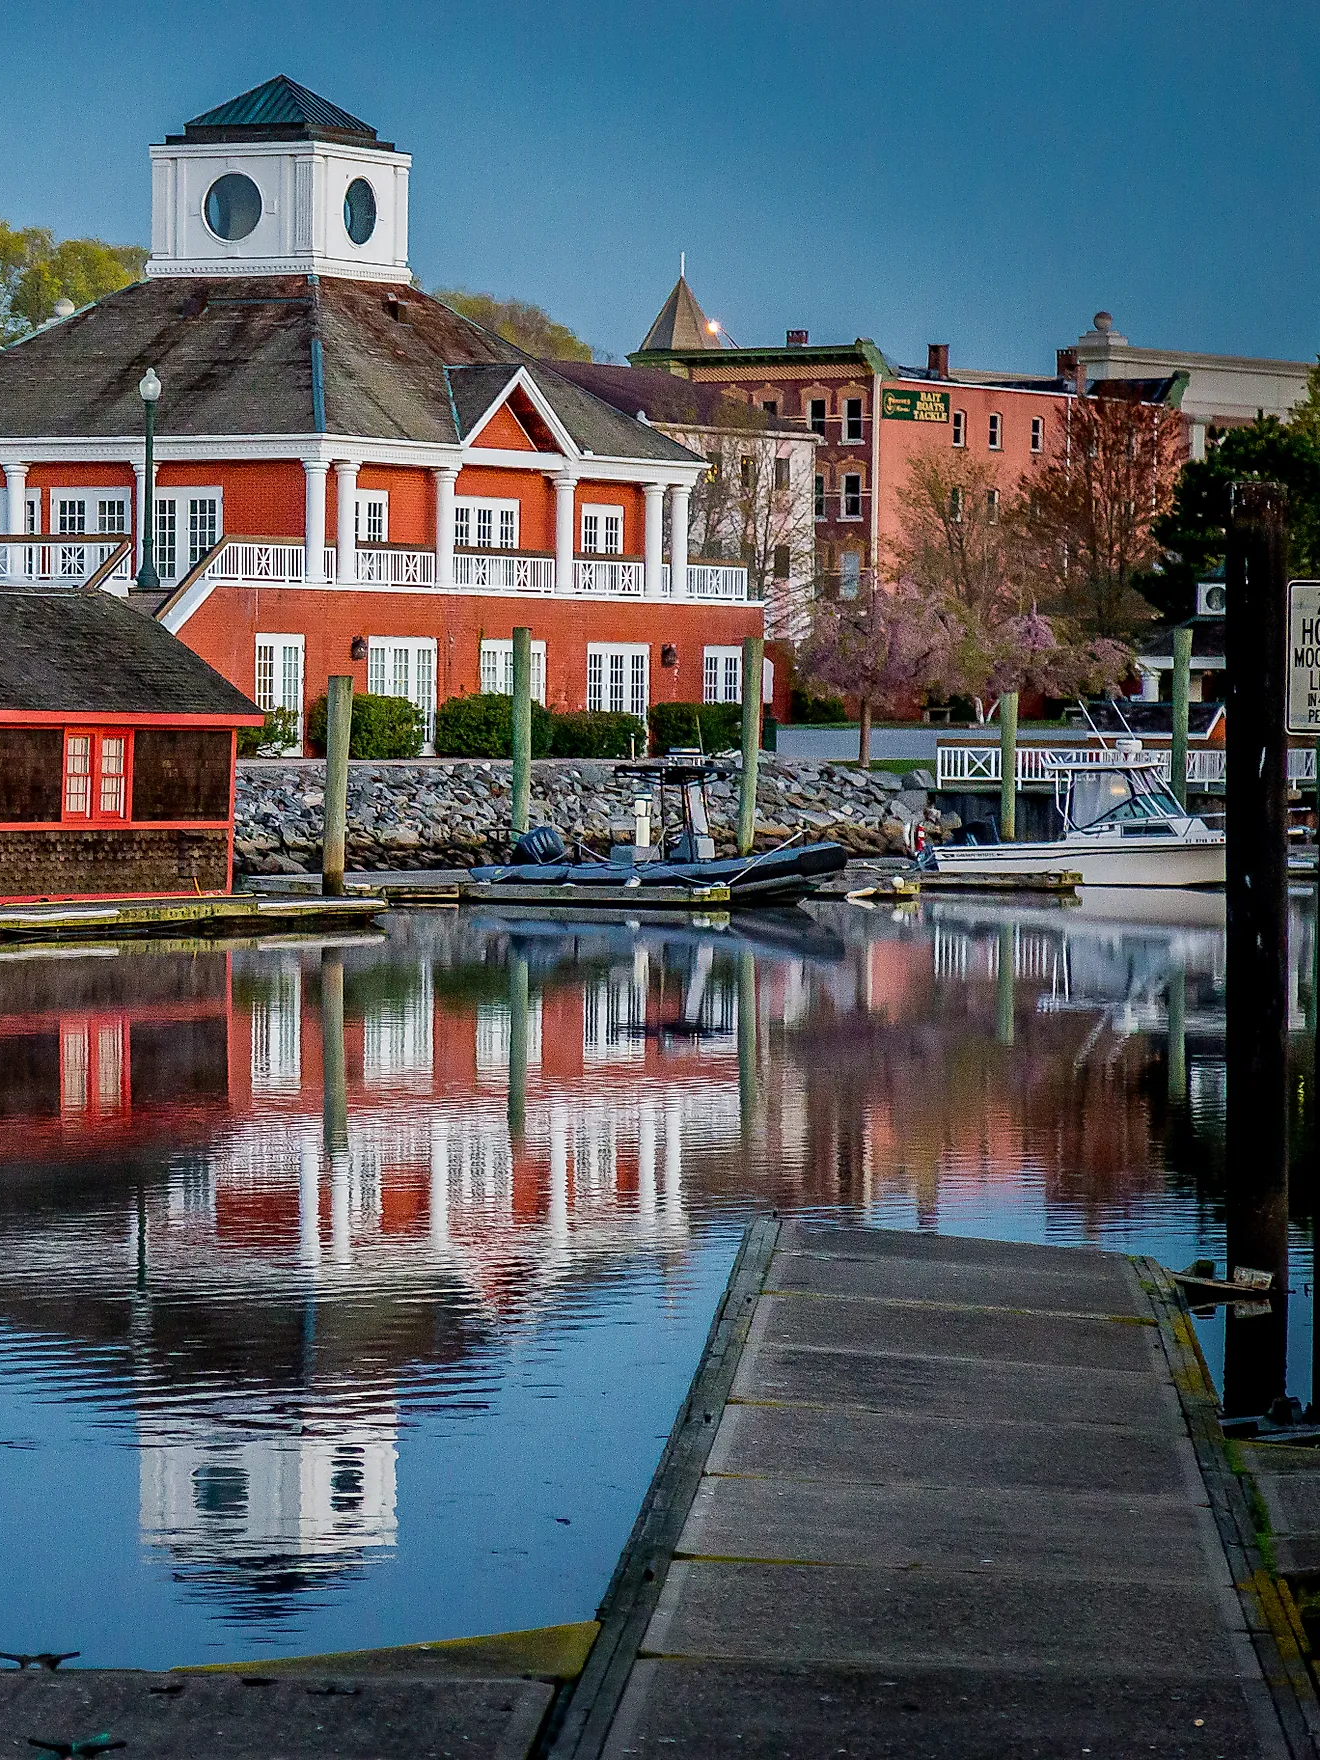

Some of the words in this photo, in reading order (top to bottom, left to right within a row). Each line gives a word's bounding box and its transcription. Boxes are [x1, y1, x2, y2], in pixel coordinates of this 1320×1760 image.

[920, 392, 941, 402] BAIT
[916, 401, 945, 411] BOATS
[913, 410, 948, 421] TACKLE
